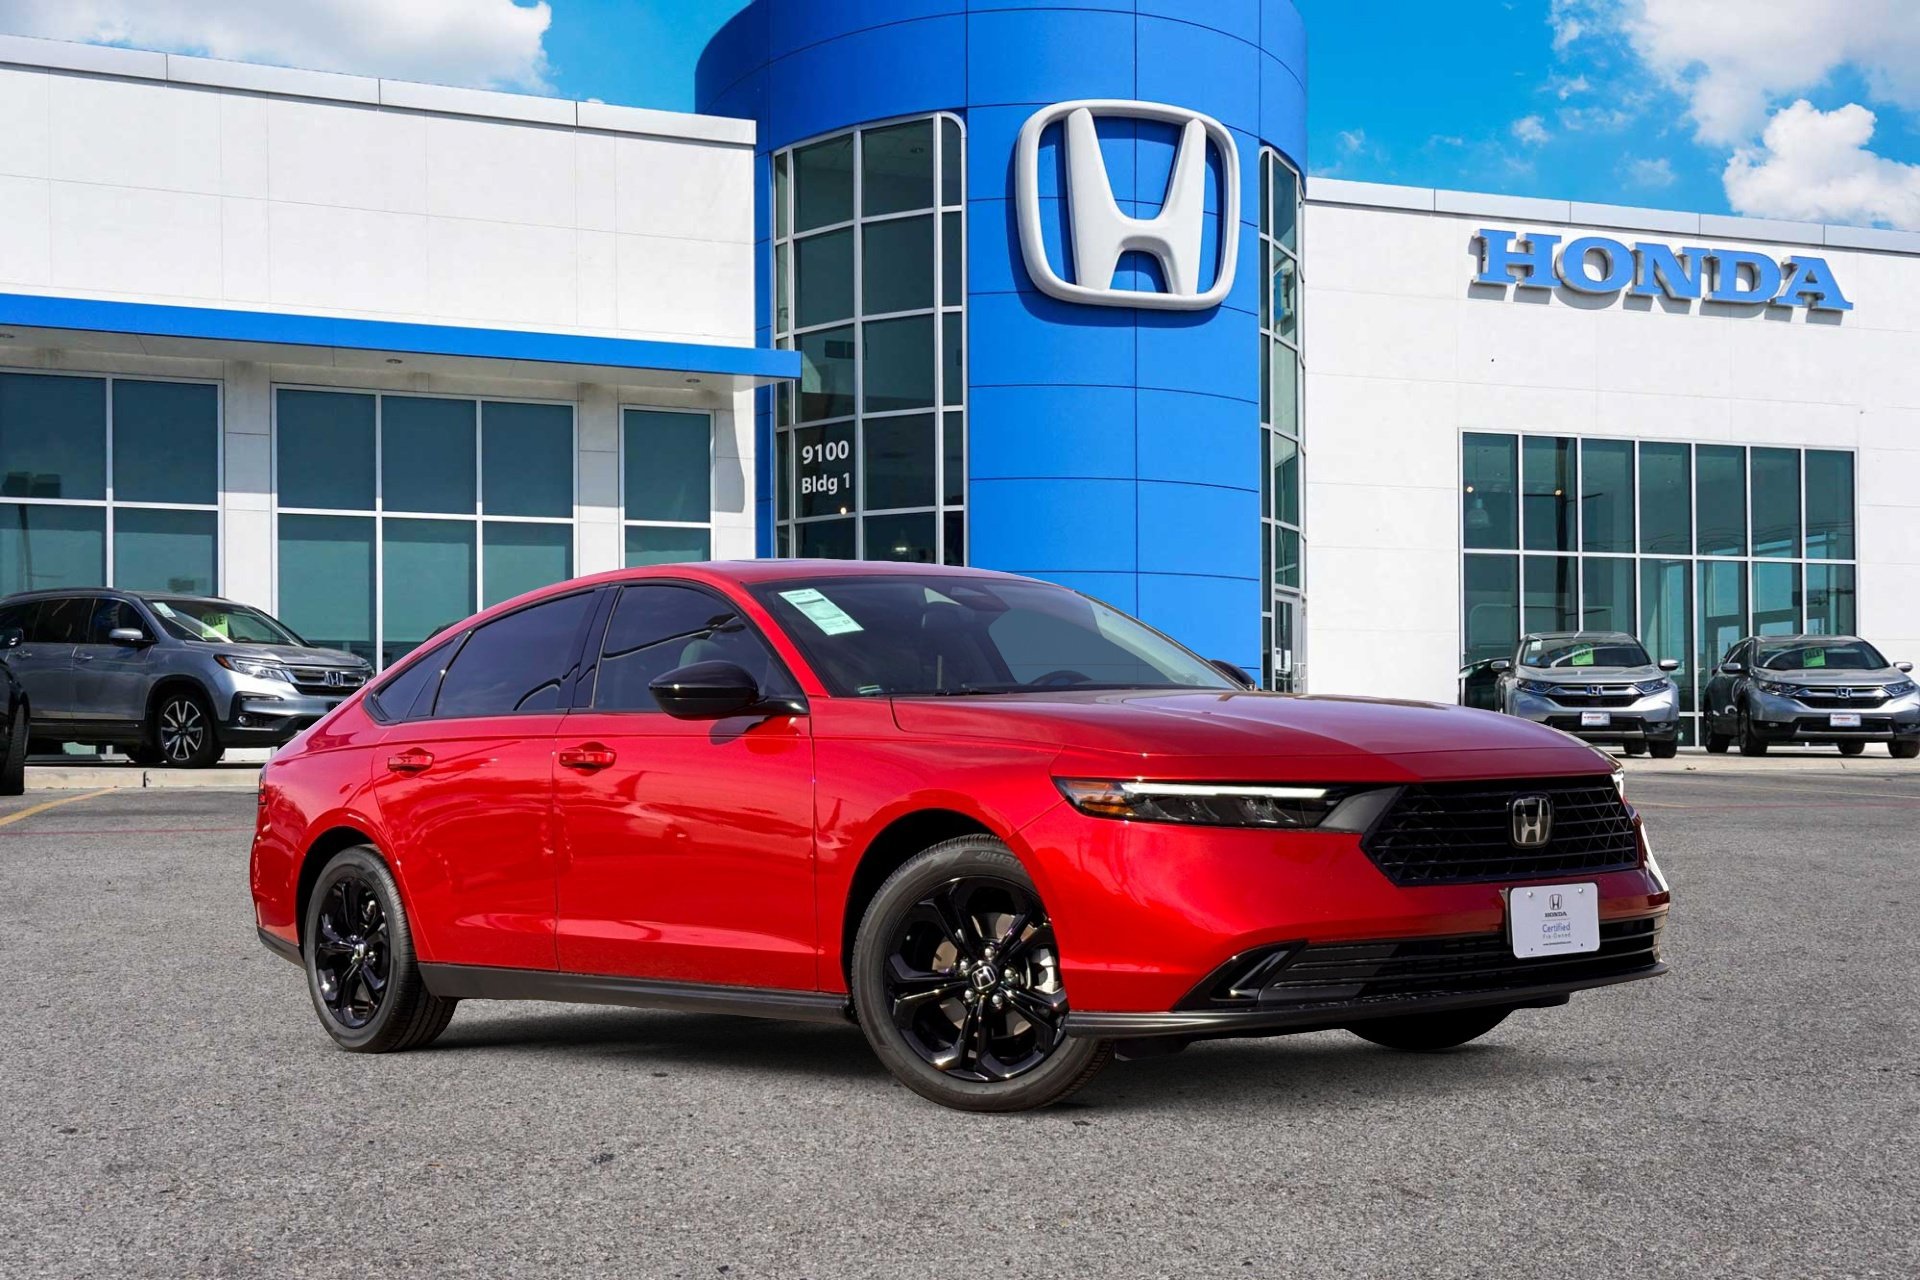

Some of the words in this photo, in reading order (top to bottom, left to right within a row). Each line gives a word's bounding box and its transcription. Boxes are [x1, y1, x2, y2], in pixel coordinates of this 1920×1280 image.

[1474, 228, 1853, 310] HONDA
[802, 440, 850, 465] 9100
[801, 474, 838, 495] Bldg
[843, 472, 850, 489] 1
[1542, 922, 1570, 933] Certified
